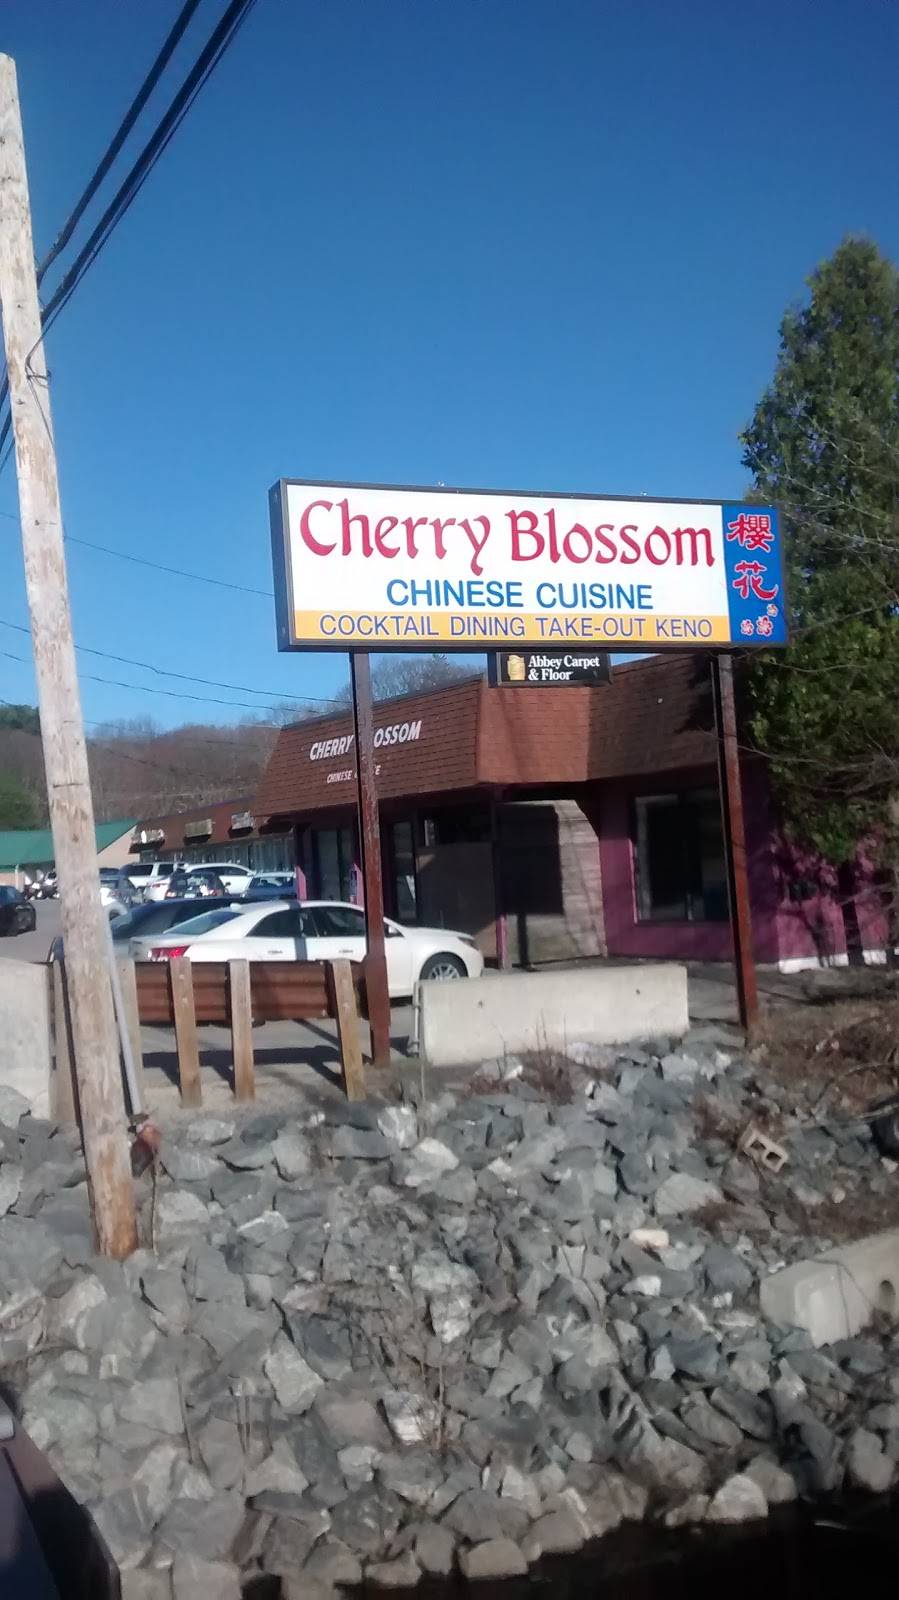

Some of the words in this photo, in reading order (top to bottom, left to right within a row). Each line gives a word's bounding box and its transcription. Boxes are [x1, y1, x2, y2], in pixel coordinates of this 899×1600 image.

[300, 498, 491, 576] Cherry
[504, 507, 716, 568] Blossom
[386, 578, 524, 608] CHINESE
[535, 582, 654, 610] CUISINE
[320, 614, 439, 636] COCKTAIL
[450, 616, 525, 637] DINING
[535, 617, 647, 640] TAKE-OUT
[655, 619, 713, 638] KENO
[528, 655, 562, 669] Abbey
[563, 654, 600, 670] Carpet
[528, 668, 539, 681] &
[541, 668, 573, 681] Floor
[310, 735, 355, 761] CHERRY
[374, 721, 422, 748] OSSOM
[326, 769, 353, 784] CHINESE
